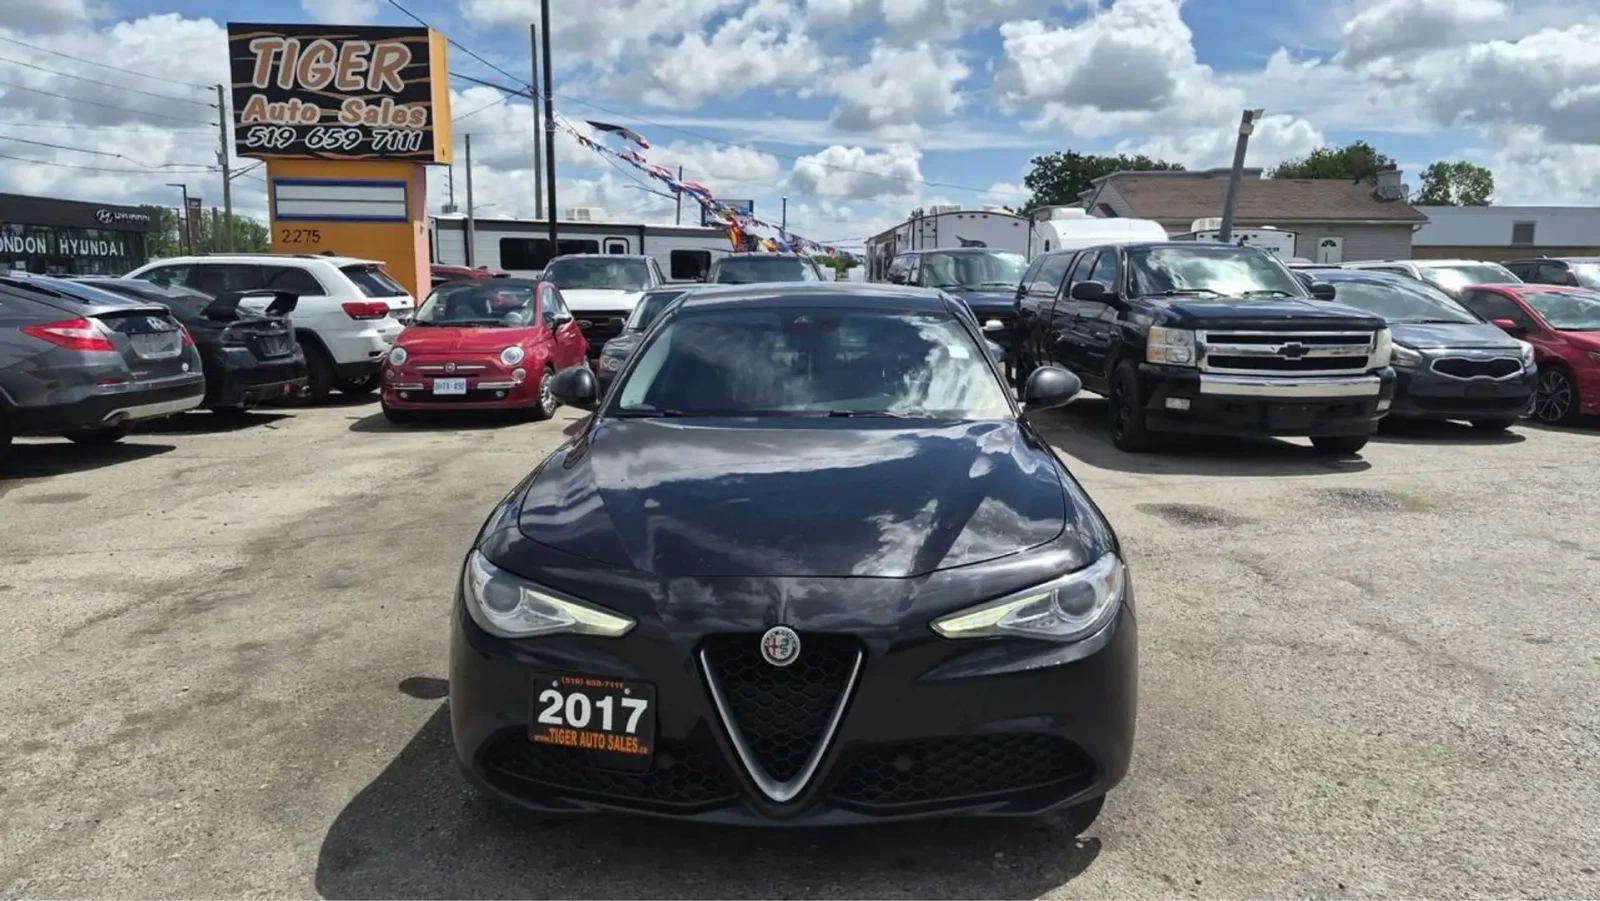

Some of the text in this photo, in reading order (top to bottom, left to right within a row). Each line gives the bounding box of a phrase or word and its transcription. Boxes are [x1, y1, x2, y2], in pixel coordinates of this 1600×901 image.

[249, 37, 411, 93] TIGER
[241, 94, 427, 128] Auto Sales
[246, 126, 423, 151] 519 659 7111
[0, 236, 124, 256] NDON HYUNDAI
[281, 229, 321, 243] 2275
[538, 689, 648, 734] 2017
[580, 731, 606, 749] AUTO
